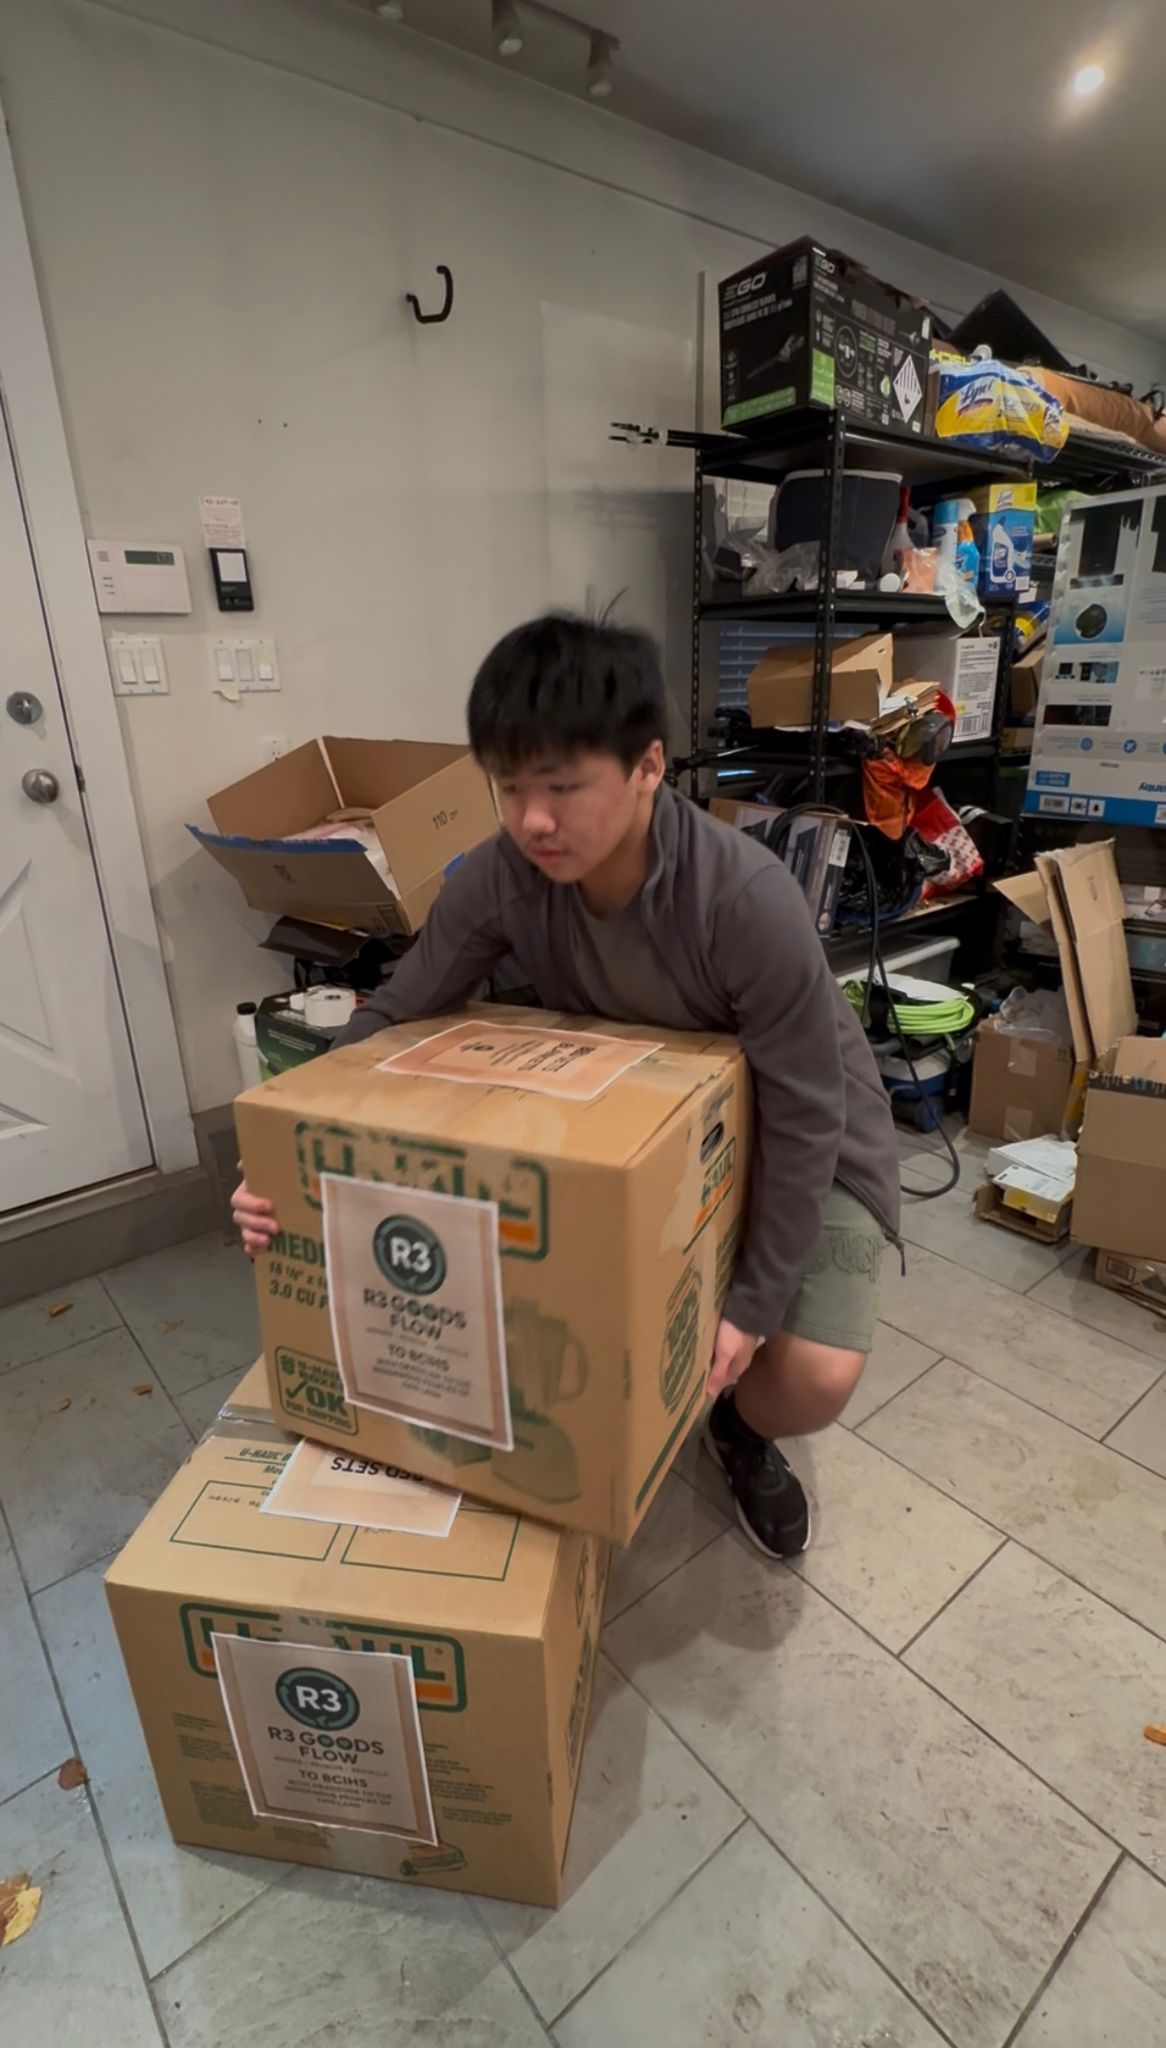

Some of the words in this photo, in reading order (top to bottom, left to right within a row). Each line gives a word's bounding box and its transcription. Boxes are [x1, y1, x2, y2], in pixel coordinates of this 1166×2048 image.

[814, 254, 835, 274] EGO
[723, 272, 768, 301] EGO
[267, 1230, 326, 1268] MEDI
[390, 1236, 433, 1275] R3
[269, 1279, 293, 1299] 3.0
[296, 1287, 316, 1307] CU
[319, 1295, 329, 1309] F
[363, 1287, 388, 1309] R3
[390, 1295, 468, 1330] GOODS
[390, 1313, 442, 1341] FLOW
[306, 1385, 348, 1416] OK
[330, 1456, 384, 1476] SETS
[296, 1685, 341, 1713] R3
[267, 1725, 295, 1743] R3
[299, 1731, 385, 1755] GOODS
[299, 1746, 358, 1765] FLOW
[298, 1769, 318, 1782] TO
